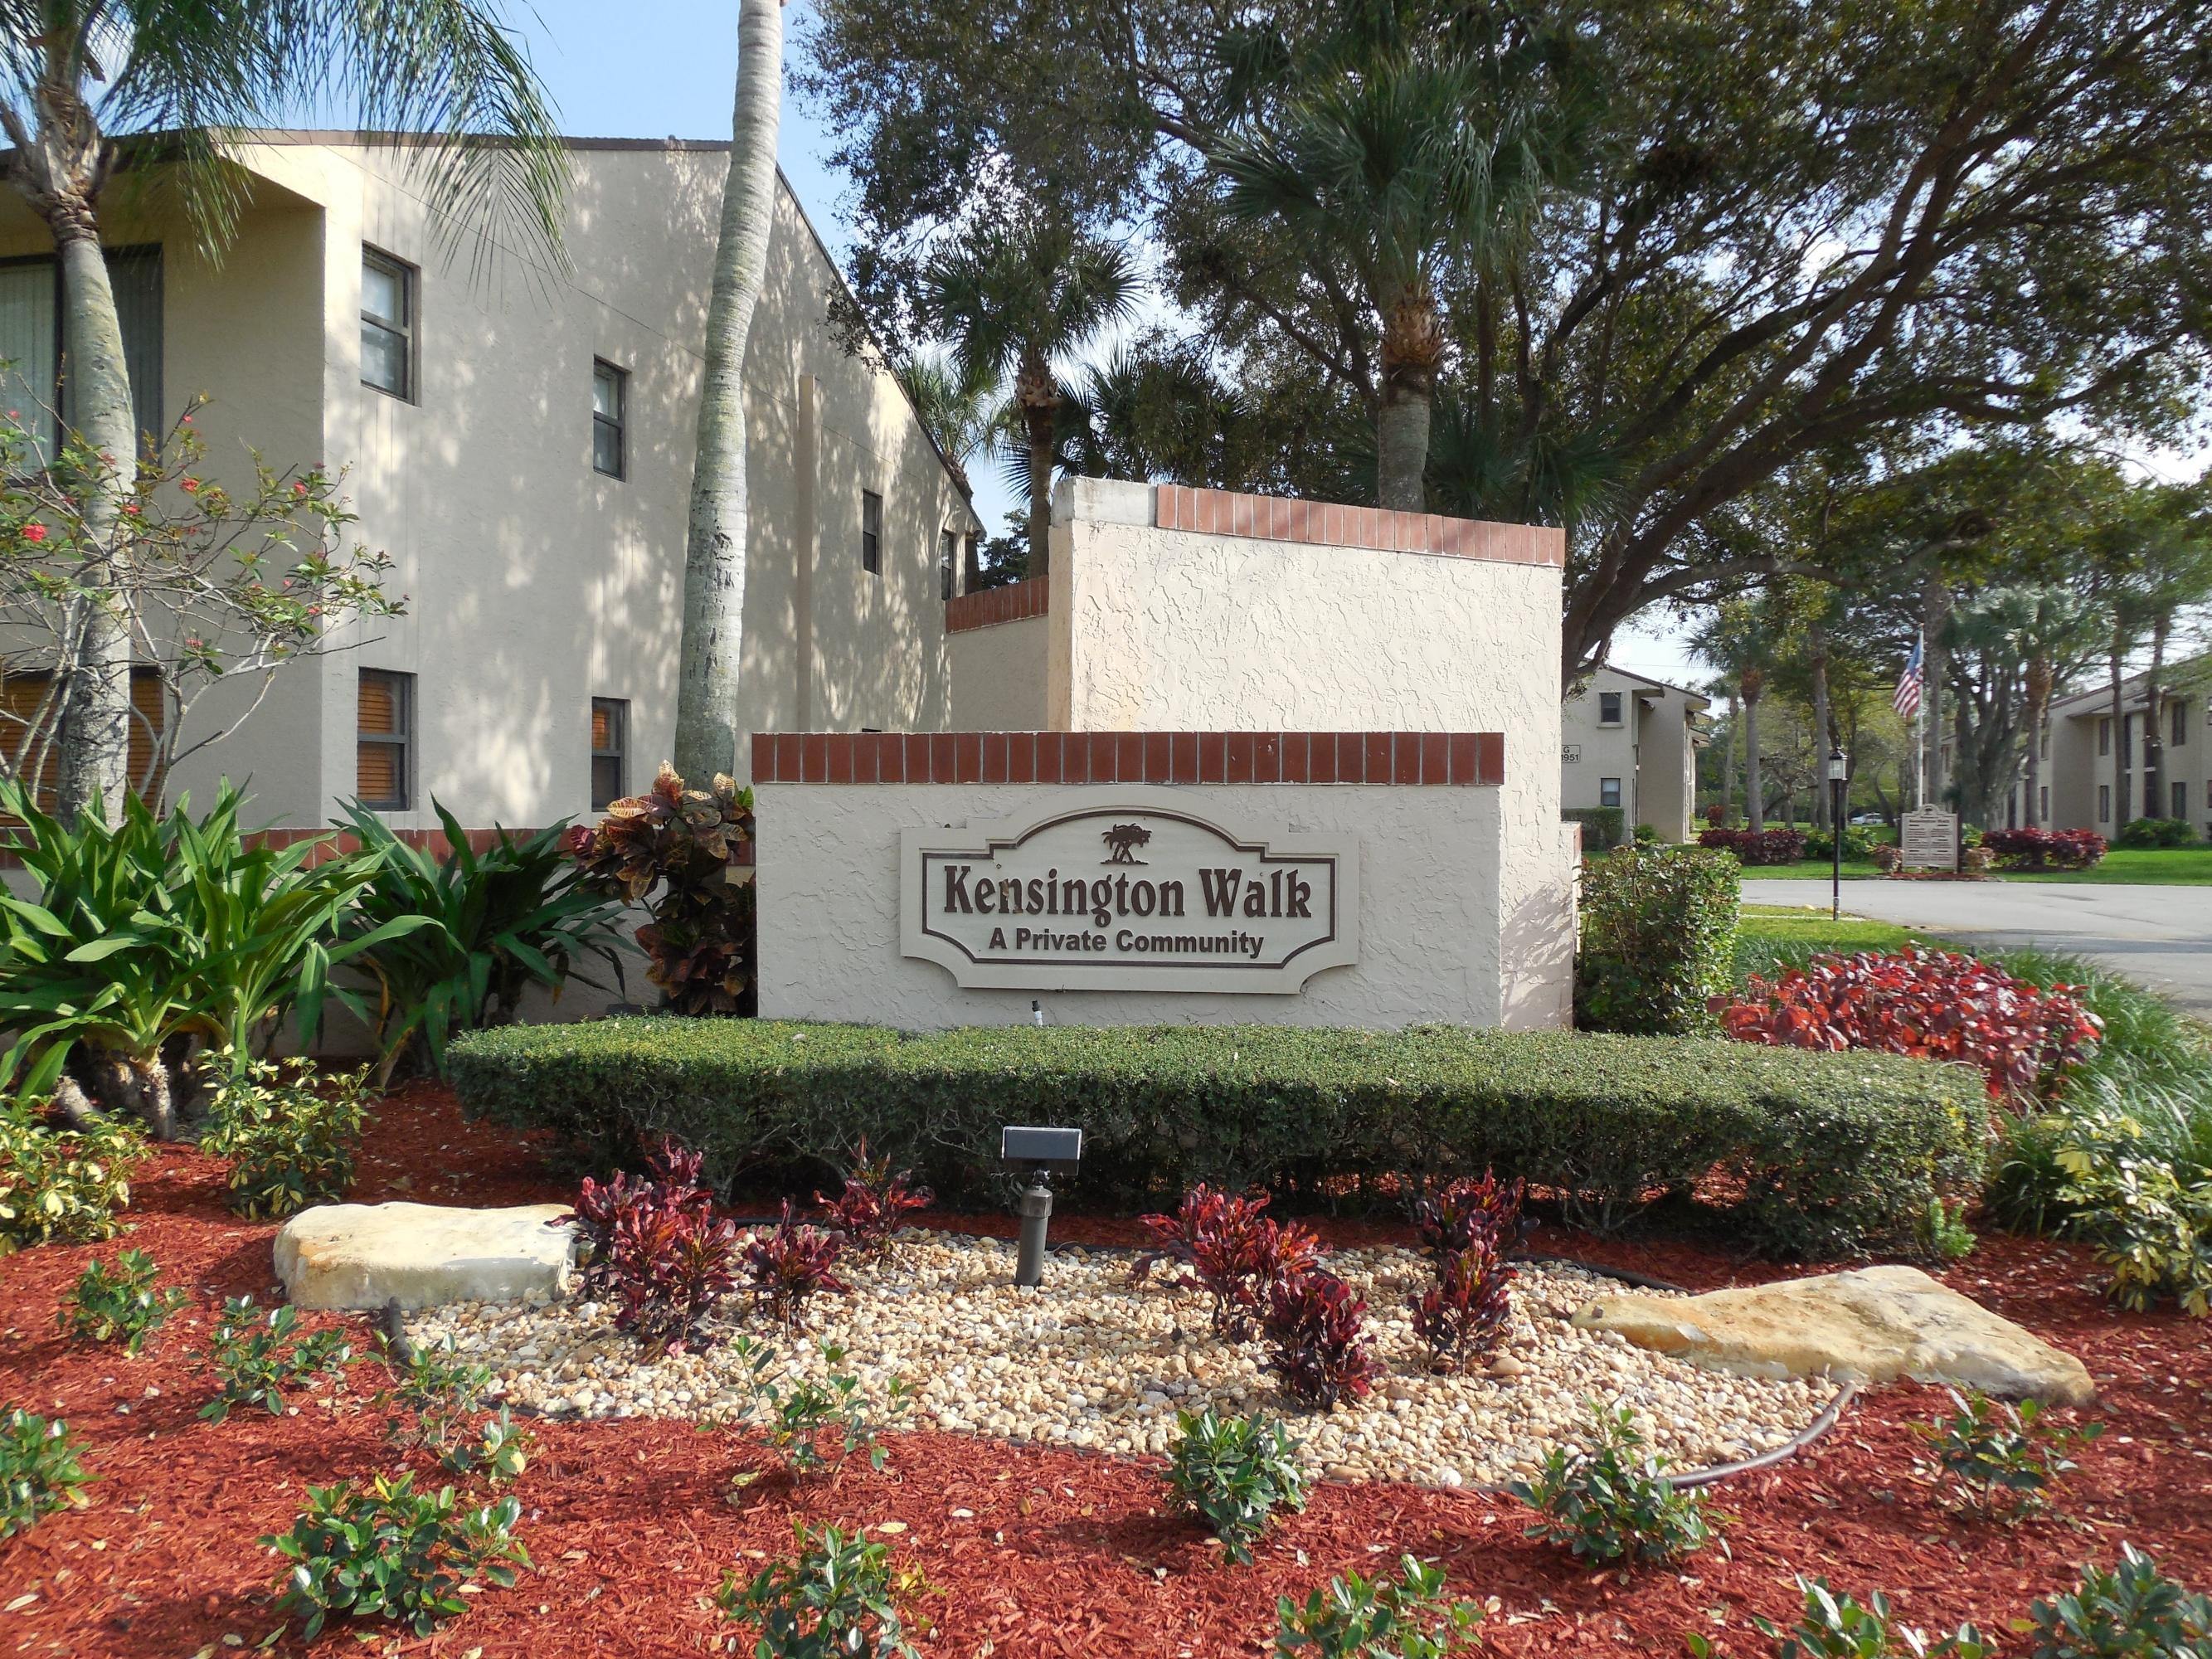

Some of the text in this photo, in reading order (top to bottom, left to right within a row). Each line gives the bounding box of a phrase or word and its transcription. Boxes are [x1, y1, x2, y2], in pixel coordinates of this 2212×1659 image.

[943, 865, 1312, 928] Kensington Walk
[988, 927, 1265, 960] A Private Community
